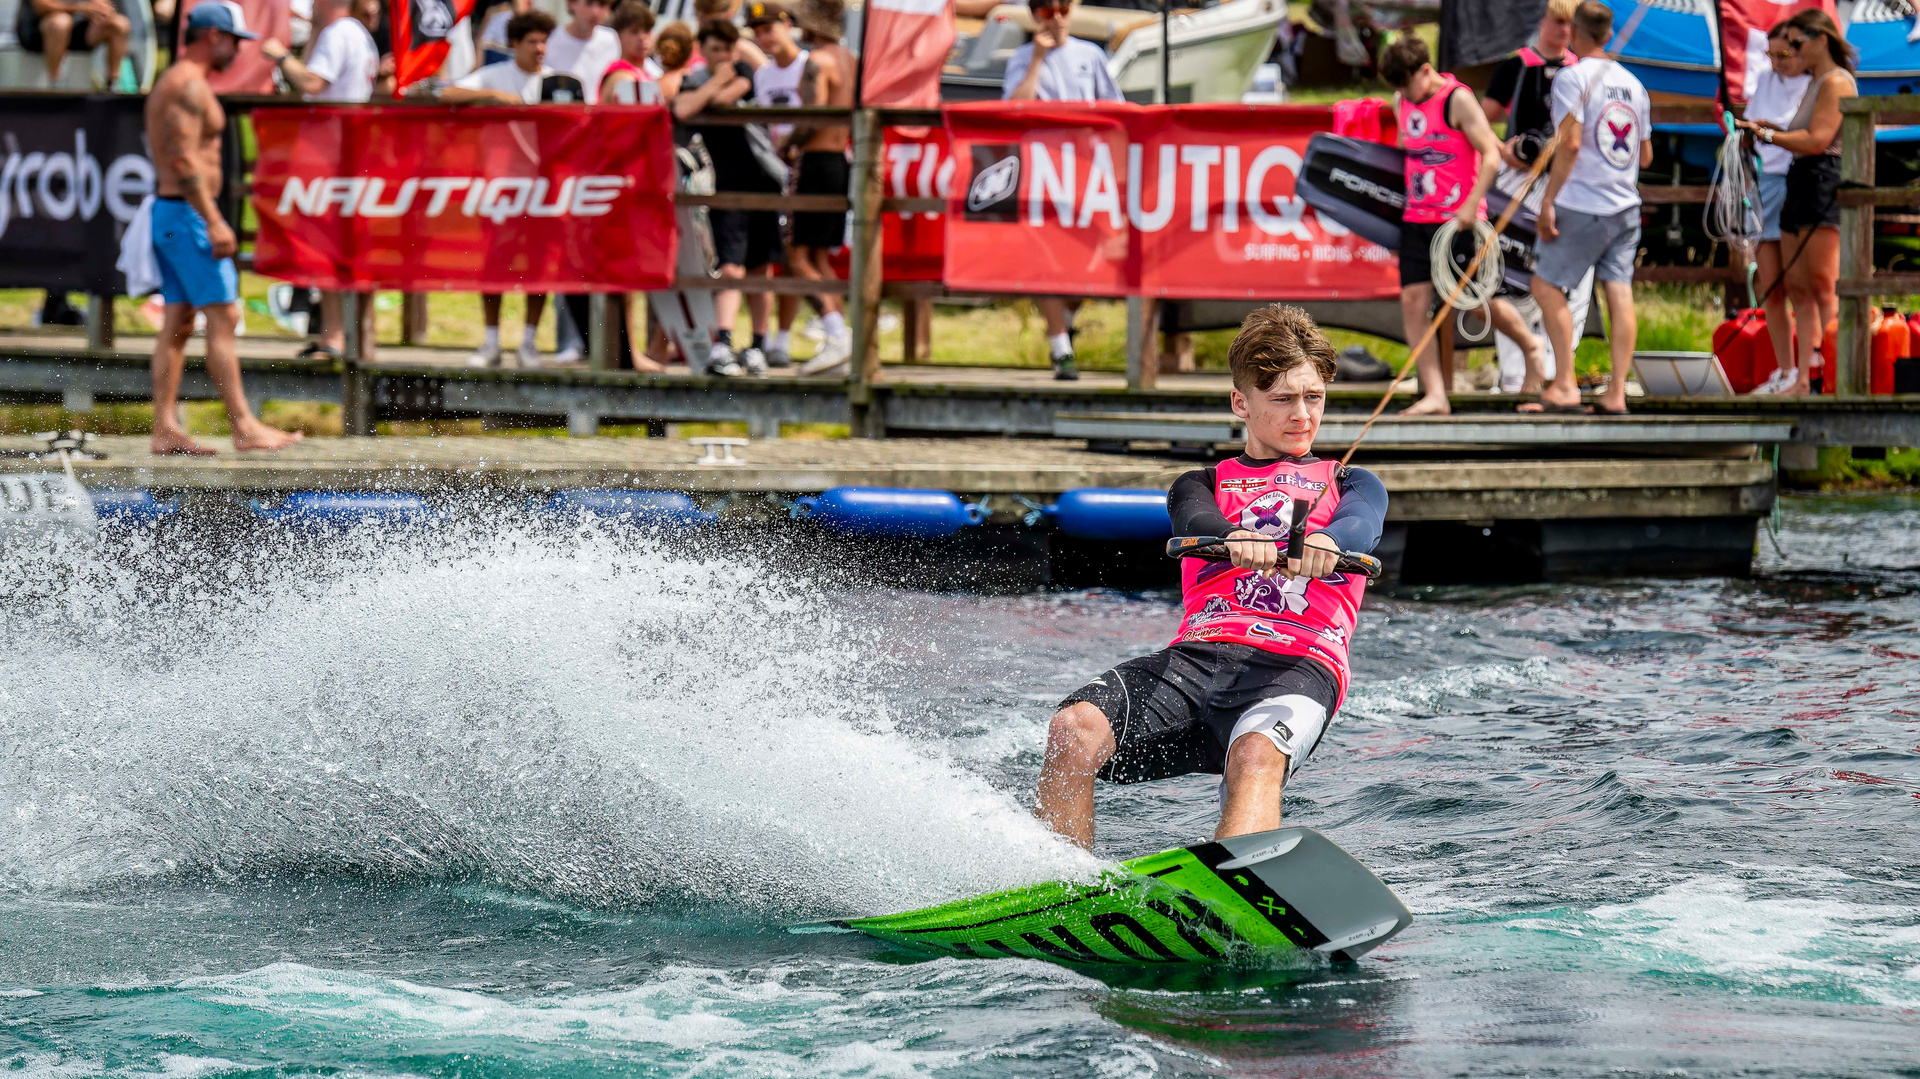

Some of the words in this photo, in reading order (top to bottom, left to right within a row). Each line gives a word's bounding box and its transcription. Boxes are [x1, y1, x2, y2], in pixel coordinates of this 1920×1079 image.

[277, 175, 625, 223] NAUTIQUE
[1029, 142, 1350, 240] NAUTIQ
[1274, 474, 1296, 486] CLIFF
[1298, 479, 1327, 492] LAKES
